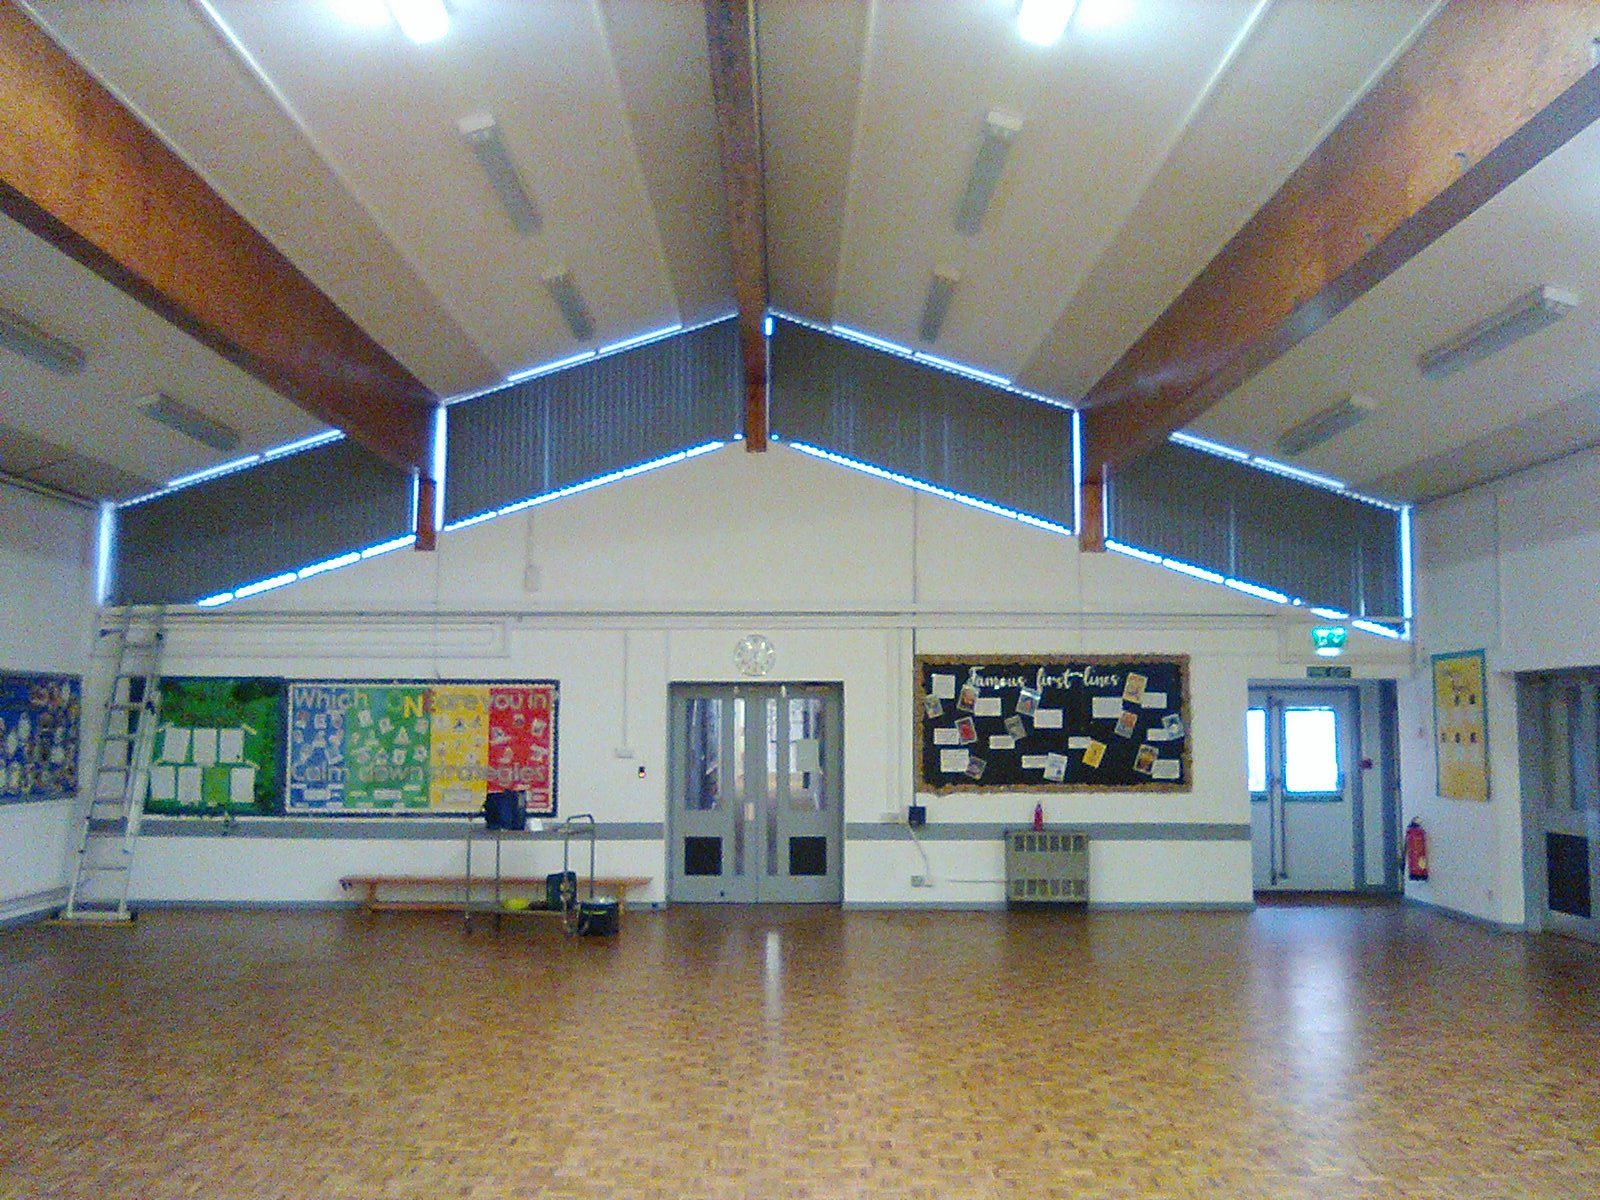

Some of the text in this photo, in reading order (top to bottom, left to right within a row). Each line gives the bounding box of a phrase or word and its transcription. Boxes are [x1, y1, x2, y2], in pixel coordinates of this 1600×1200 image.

[967, 665, 1119, 694] Famous first lines
[295, 688, 369, 710] Which
